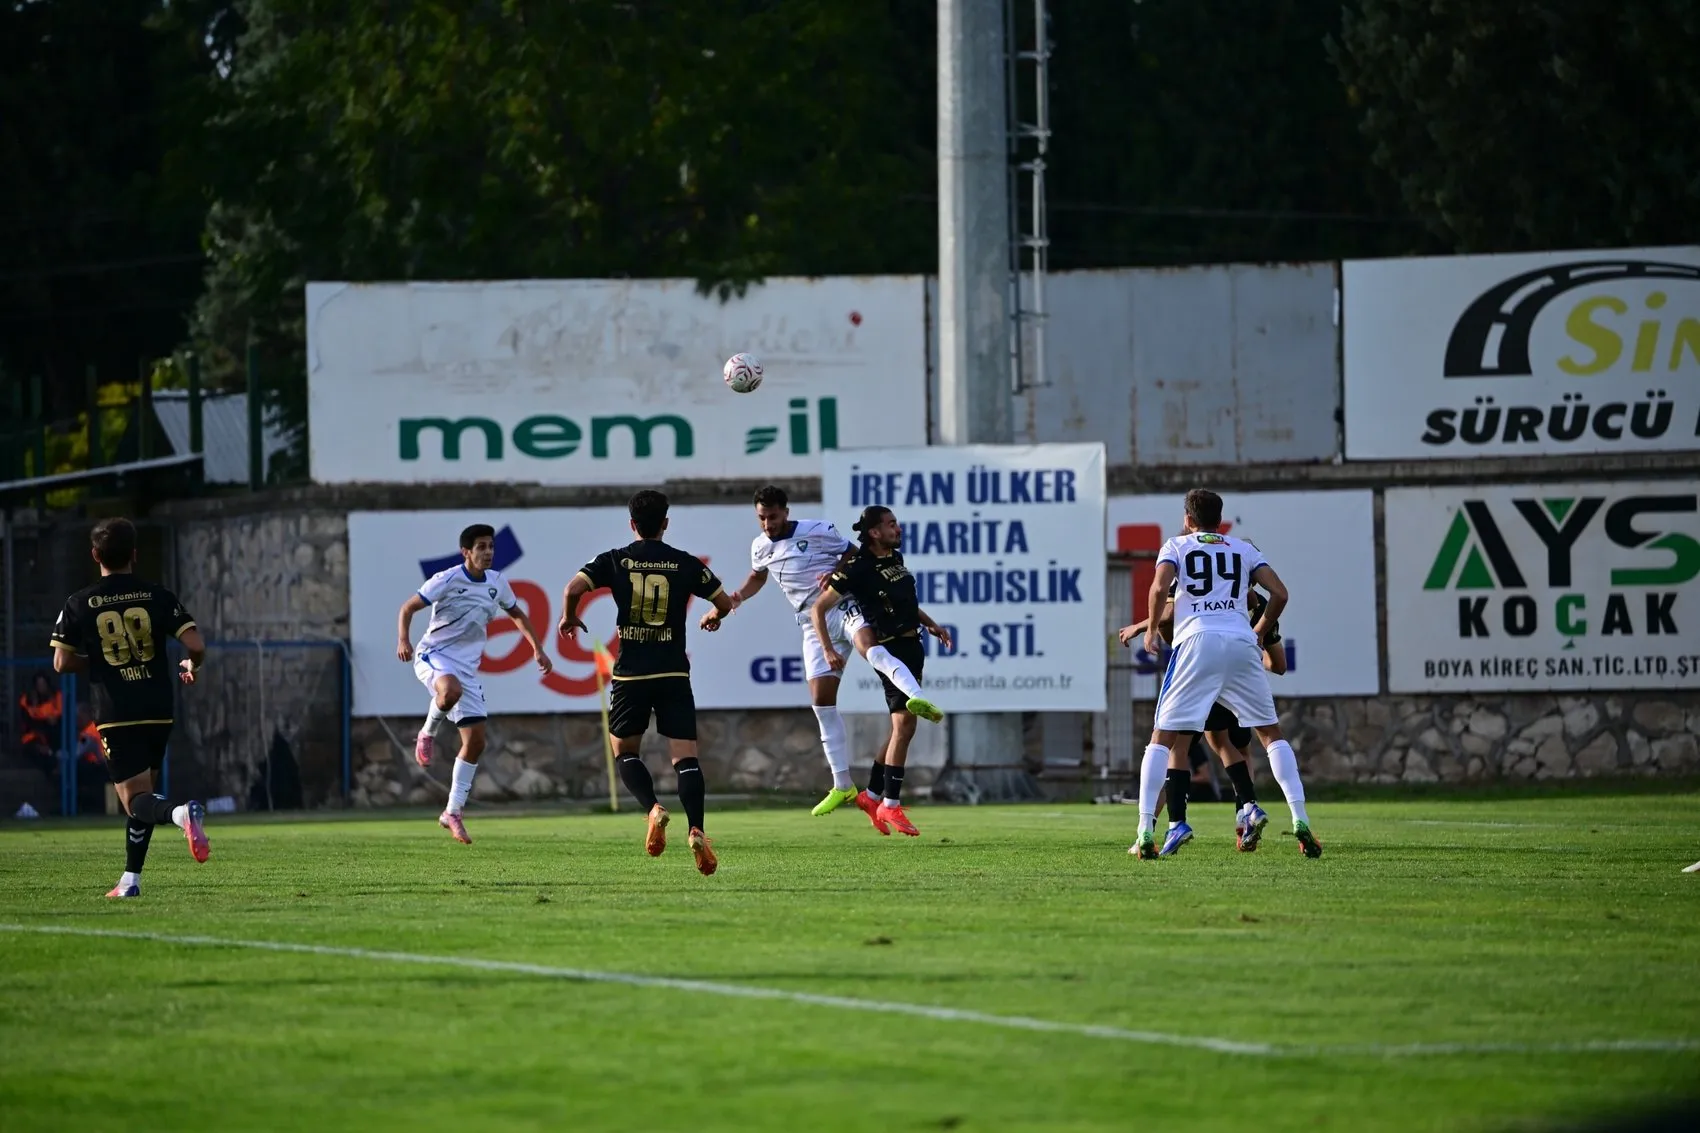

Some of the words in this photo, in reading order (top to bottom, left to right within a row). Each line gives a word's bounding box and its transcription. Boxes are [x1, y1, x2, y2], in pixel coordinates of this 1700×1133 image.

[1421, 389, 1674, 446] SÜRÜCÜ
[851, 465, 954, 506] İRFAN
[967, 465, 1077, 505] ÜLKER
[901, 512, 1029, 554] HARİTA
[634, 560, 679, 569] Erdemirler
[1185, 550, 1242, 599] 94
[629, 572, 670, 626] 10
[1191, 603, 1201, 613] T.
[1204, 600, 1235, 611] KAYA
[1458, 592, 1679, 650] KOÇAK
[980, 615, 1044, 662] ŞTİ.
[1424, 659, 1474, 678] BOYA
[1480, 654, 1538, 680] KİREÇ
